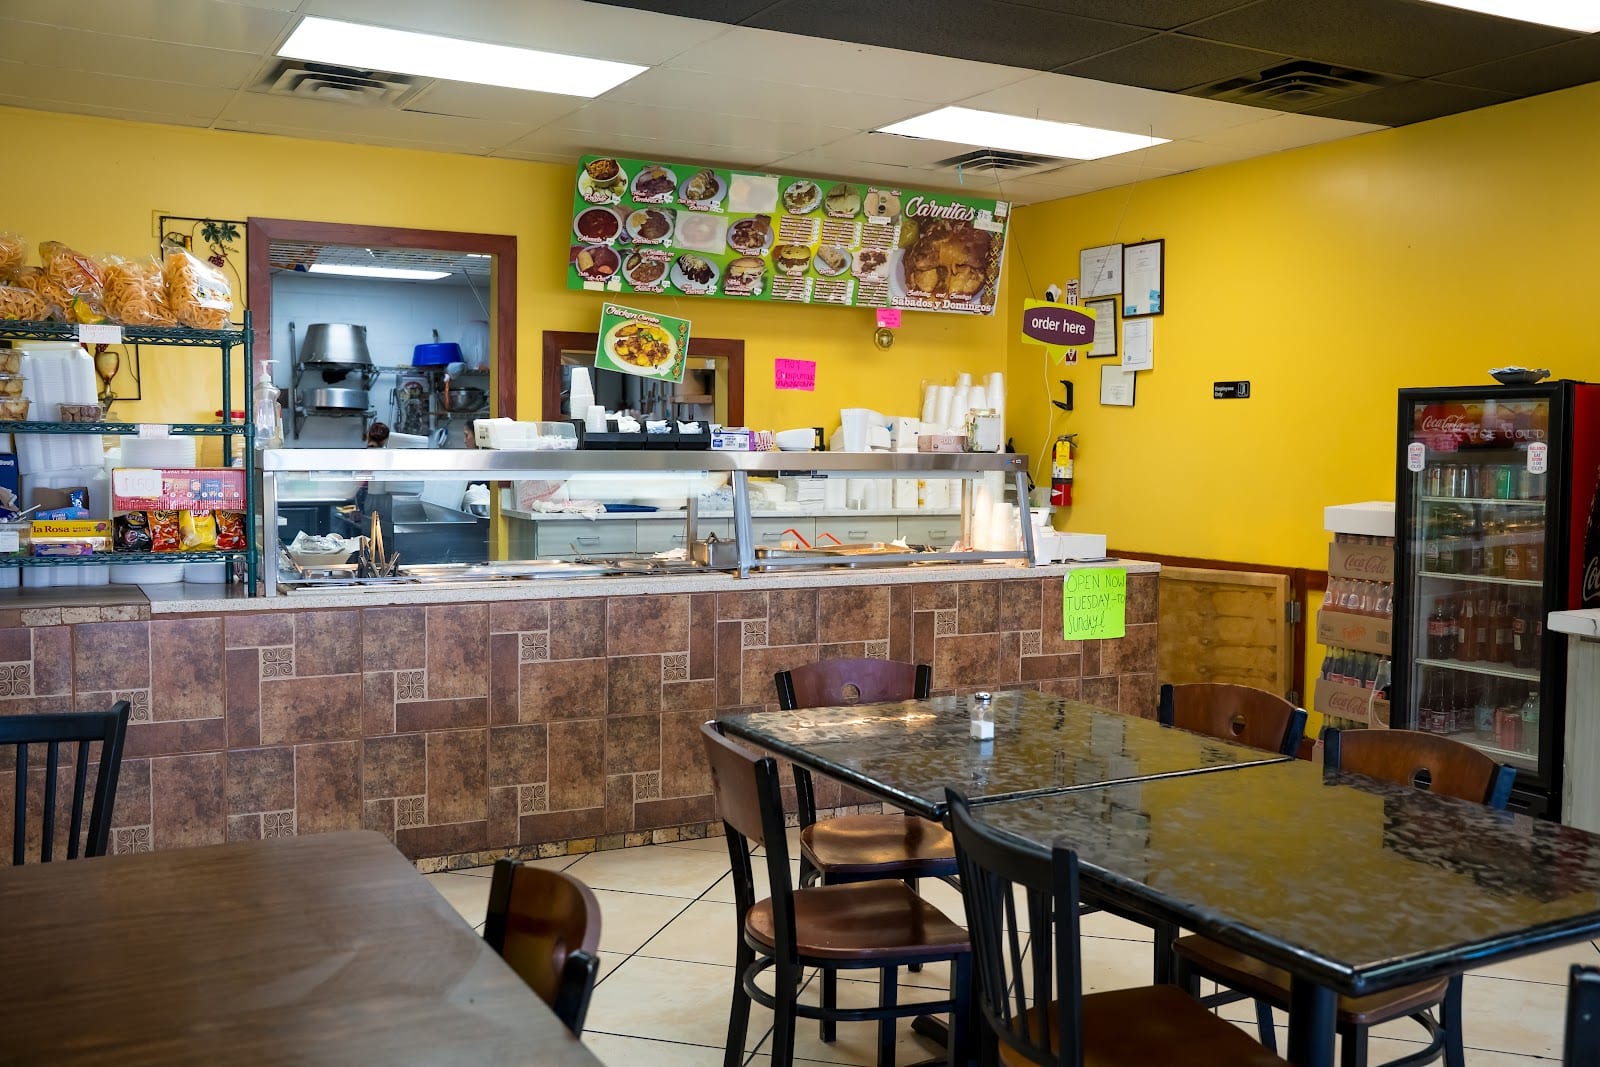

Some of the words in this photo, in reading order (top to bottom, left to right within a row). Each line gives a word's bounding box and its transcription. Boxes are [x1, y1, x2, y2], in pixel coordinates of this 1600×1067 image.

[905, 196, 976, 221] Carnitas
[606, 306, 637, 319] Chicken
[933, 301, 943, 311] y
[943, 299, 992, 313] Domingos
[1031, 316, 1060, 332] order
[1062, 319, 1086, 335] here
[1504, 428, 1545, 439] COLD
[33, 525, 43, 533] la
[44, 525, 70, 533] Rosa
[1066, 574, 1100, 592] OPEN
[1066, 593, 1110, 612] TUESDAY
